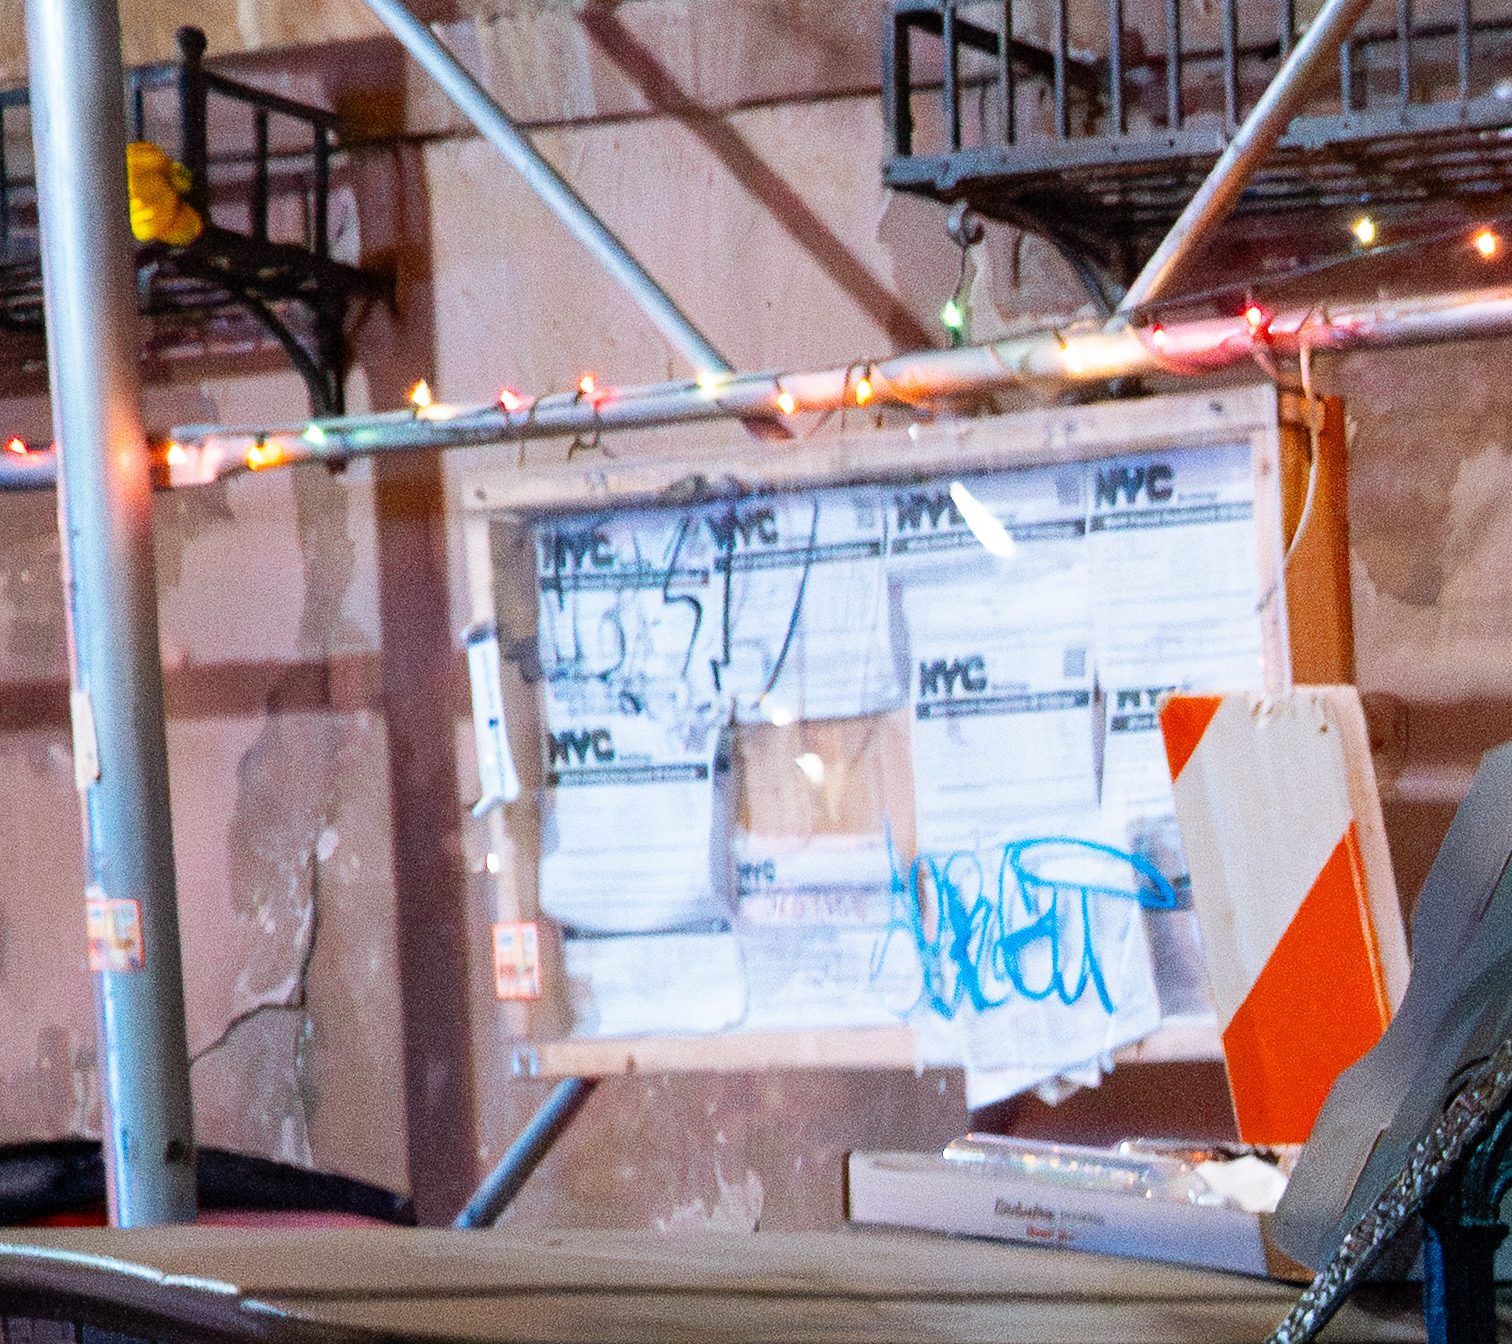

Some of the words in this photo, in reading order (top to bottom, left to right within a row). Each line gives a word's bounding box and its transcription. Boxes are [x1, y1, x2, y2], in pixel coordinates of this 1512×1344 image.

[1095, 464, 1175, 509] NYC
[918, 655, 988, 698] NYC
[549, 727, 615, 766] NYC
[737, 858, 777, 883] NYC
